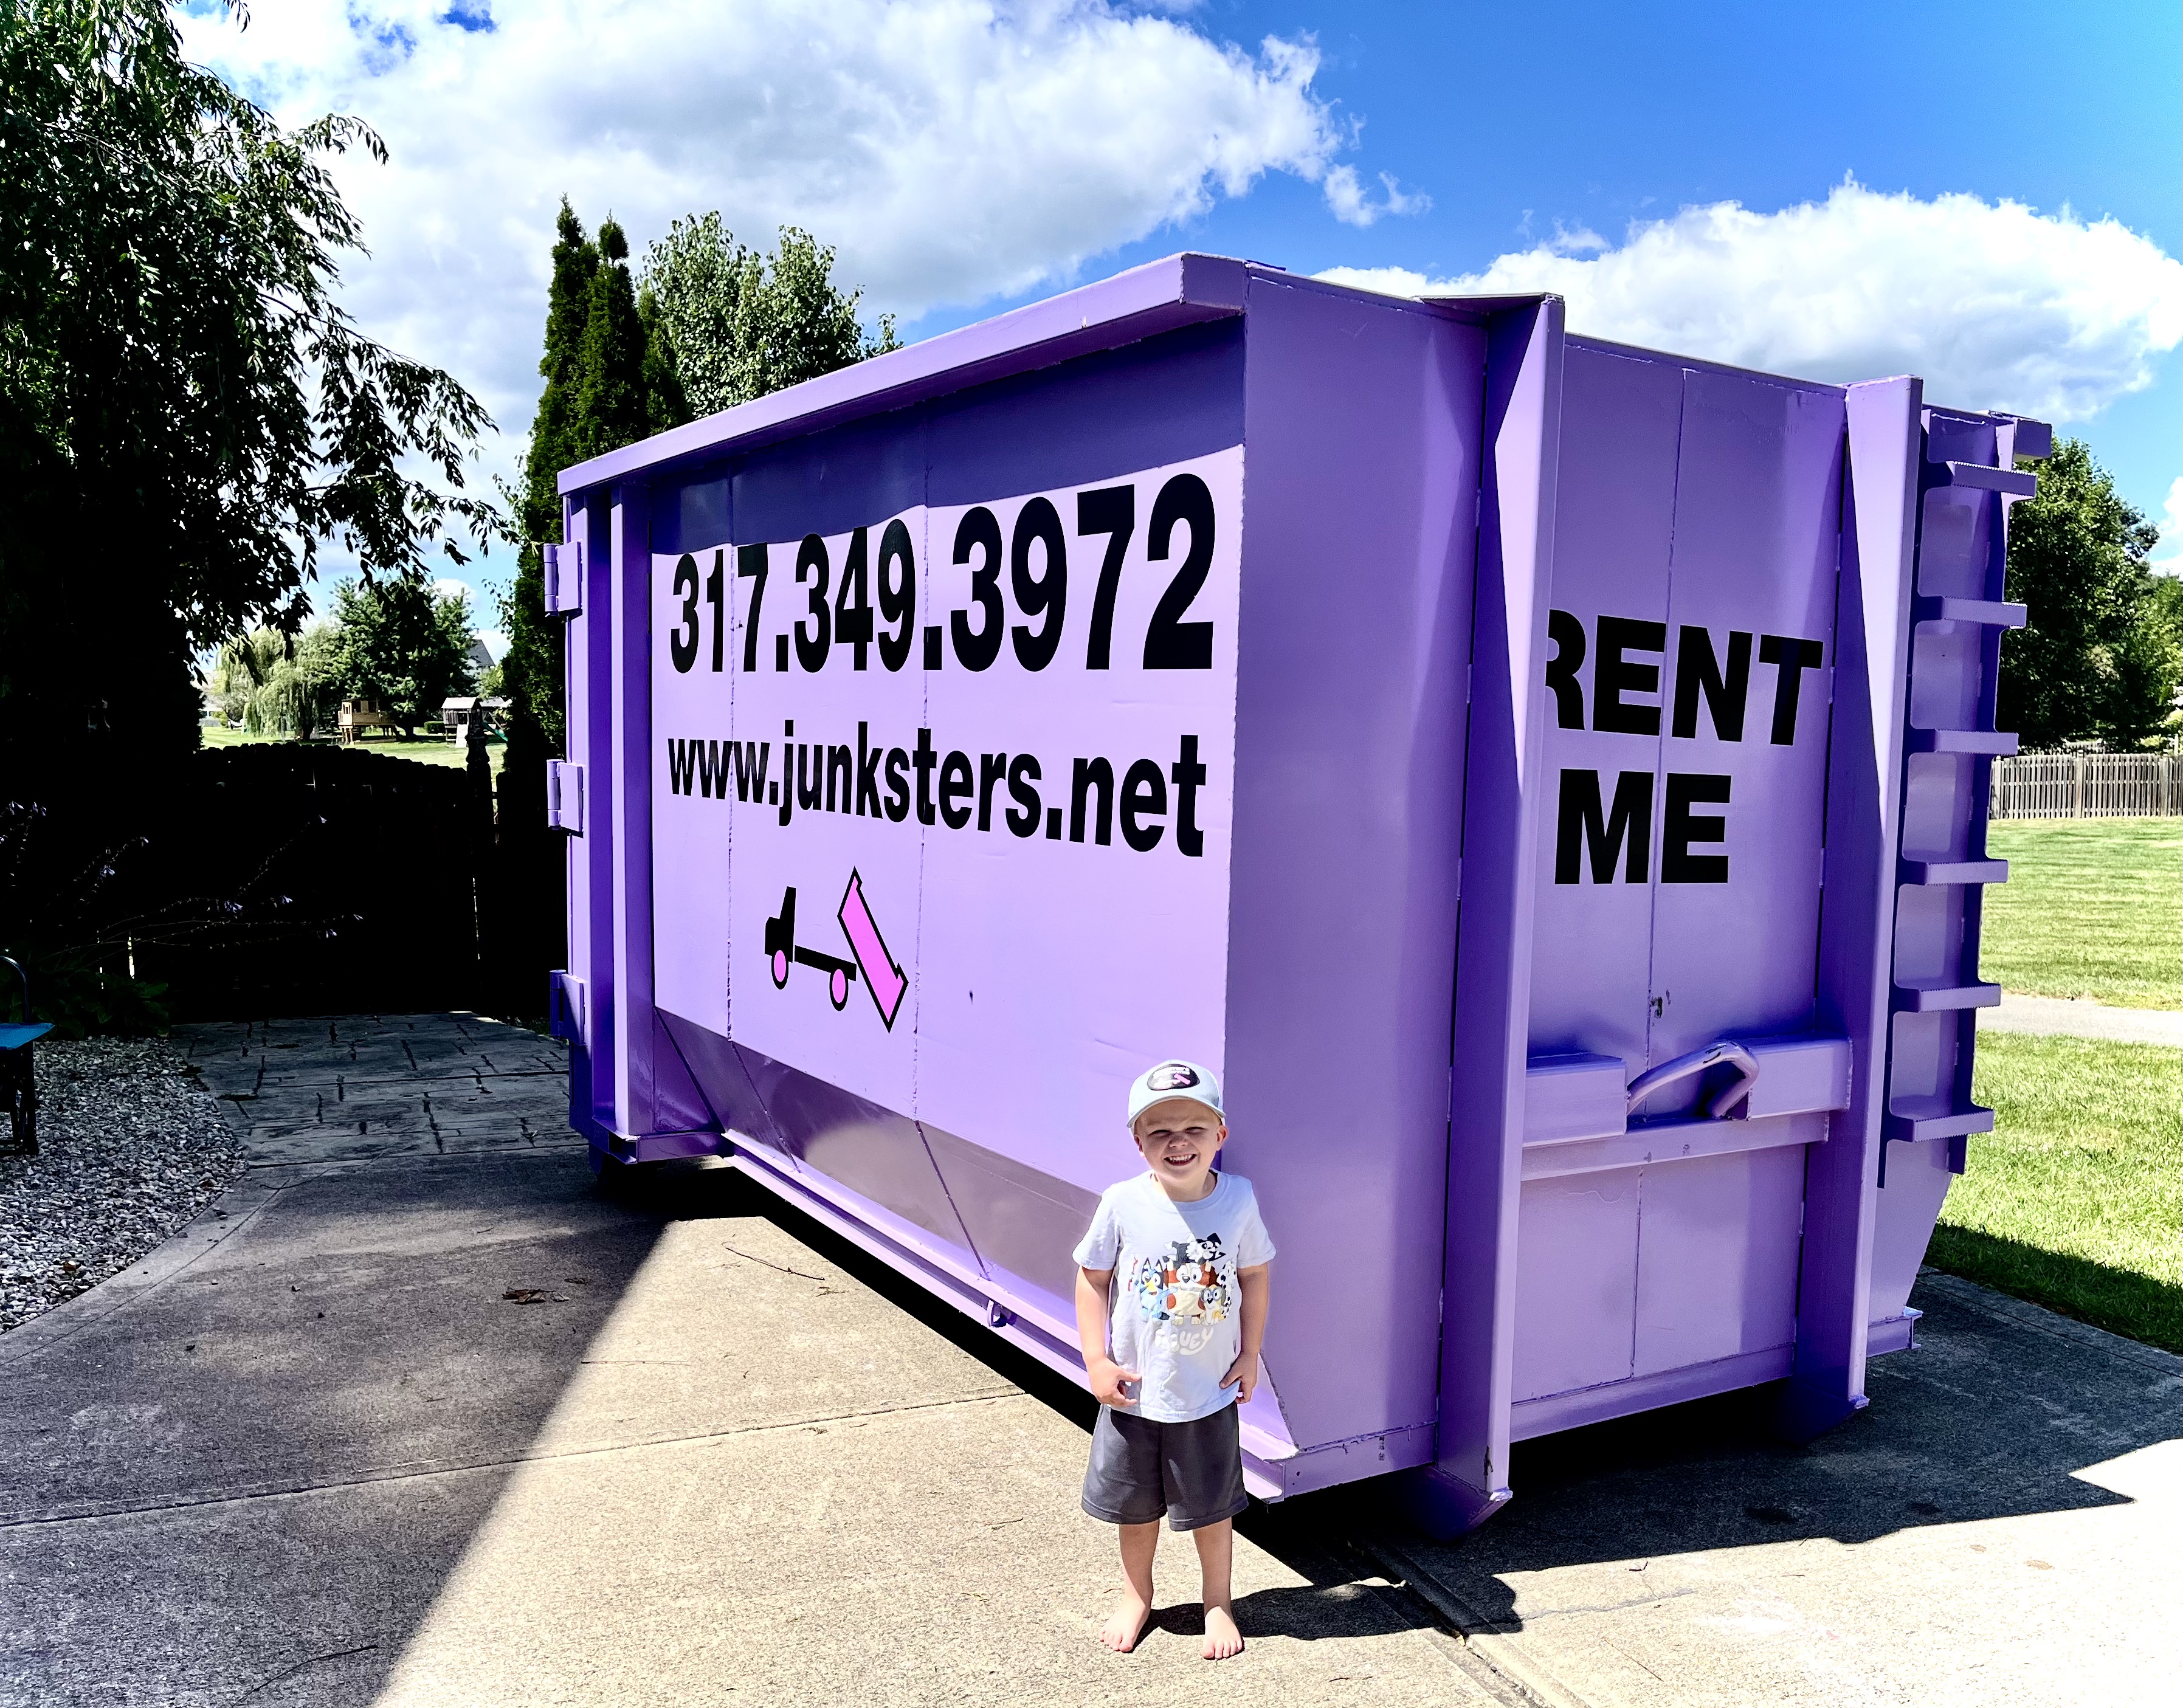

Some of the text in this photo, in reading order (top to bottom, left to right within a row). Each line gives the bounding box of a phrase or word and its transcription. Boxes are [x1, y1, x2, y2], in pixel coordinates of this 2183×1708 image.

[671, 473, 1216, 673] 317.349.3972
[667, 719, 1207, 858] www.junksters.net
[1554, 768, 1732, 884] ME
